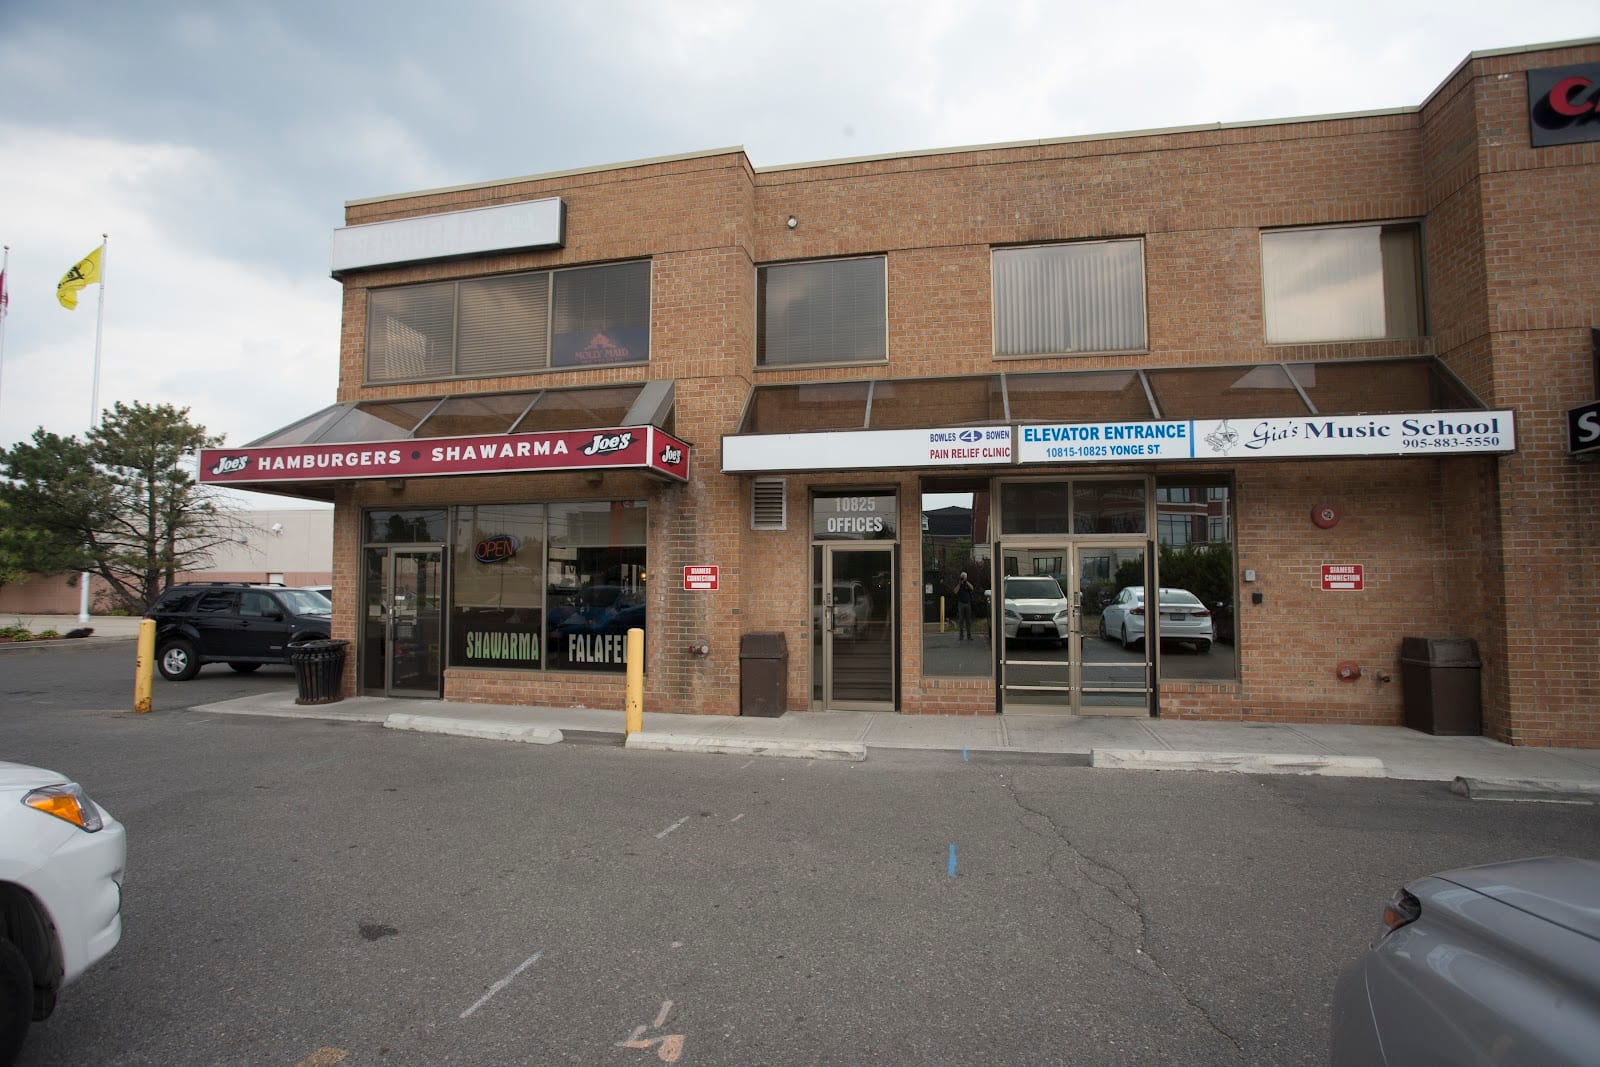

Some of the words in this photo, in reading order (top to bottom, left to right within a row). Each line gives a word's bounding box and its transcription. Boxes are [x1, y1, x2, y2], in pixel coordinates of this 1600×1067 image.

[930, 432, 957, 442] BOWLES
[986, 430, 1010, 440] BOWEN
[1024, 426, 1100, 442] ELEVATOR
[1104, 424, 1186, 440] ENTRANCE
[1244, 420, 1299, 449] Gia's
[1304, 421, 1391, 439] Music
[1402, 418, 1501, 437] School
[1402, 436, 1500, 449] 905-883-5550
[212, 455, 249, 475] Joe's
[258, 450, 402, 471] HAMBURGERS
[431, 439, 569, 462] SHAWARMA
[584, 432, 632, 456] Joe's
[930, 449, 949, 459] PAIN
[951, 447, 980, 459] RELIEF
[982, 447, 1011, 458] CLINIC
[1046, 446, 1108, 458] 10815-10825
[1109, 444, 1145, 456] YONGE
[835, 496, 876, 512] 10825
[827, 516, 883, 532] OFFICES
[476, 540, 513, 558] OPEN
[466, 631, 539, 661] SHAWARMA
